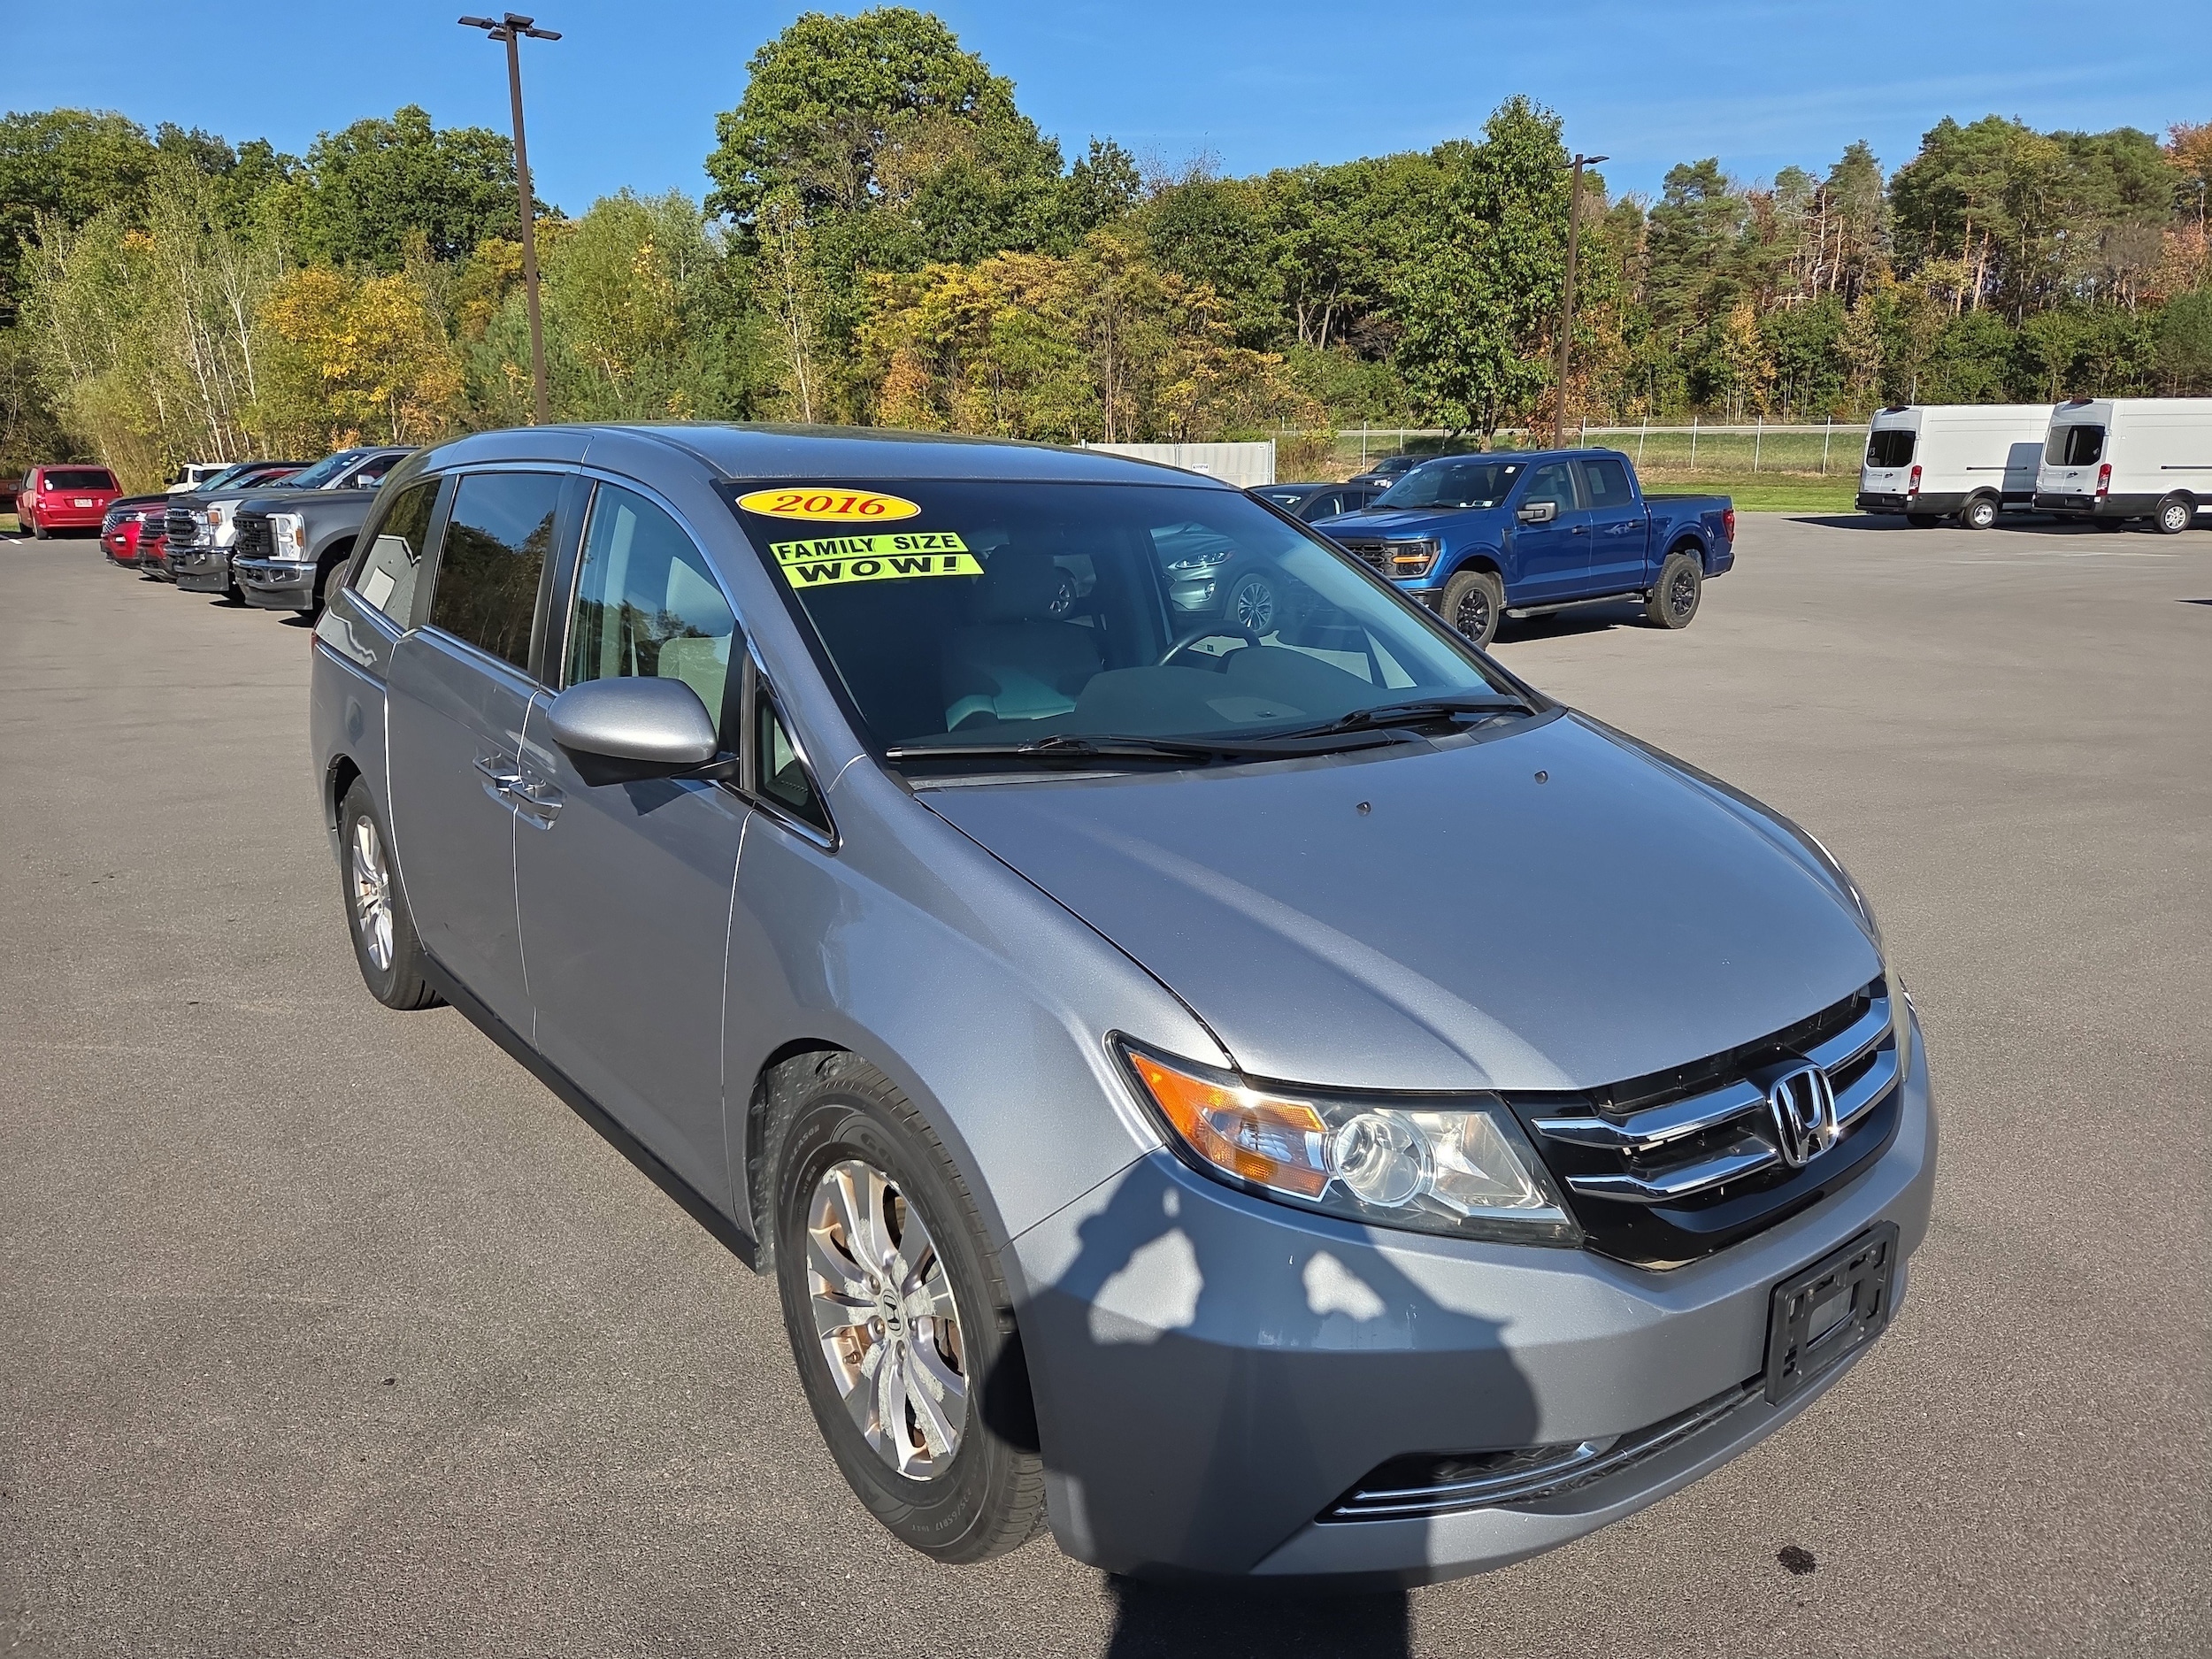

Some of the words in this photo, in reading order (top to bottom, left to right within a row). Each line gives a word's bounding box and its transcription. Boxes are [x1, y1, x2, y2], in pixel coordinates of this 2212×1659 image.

[770, 495, 889, 515] 2016
[777, 537, 875, 560] FAMILY
[893, 534, 958, 550] SIZE
[796, 556, 958, 582] WOW!
